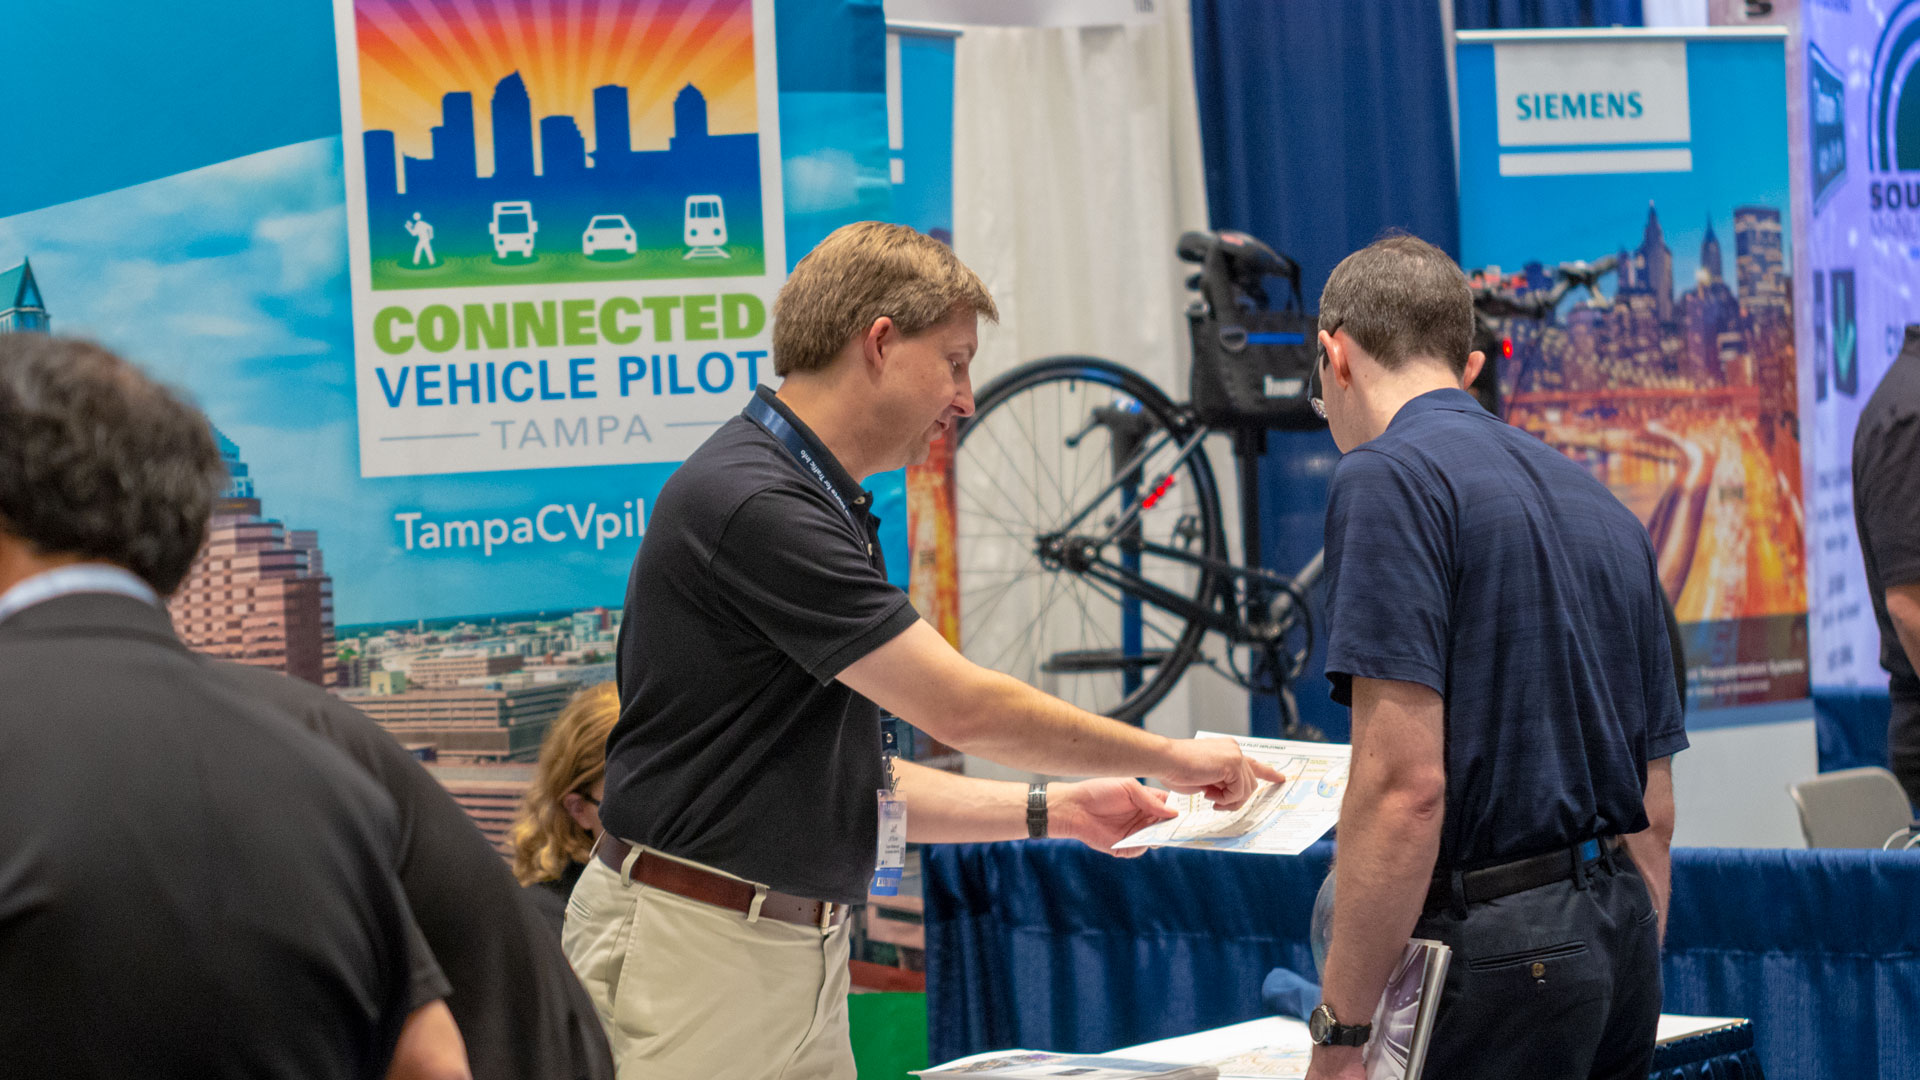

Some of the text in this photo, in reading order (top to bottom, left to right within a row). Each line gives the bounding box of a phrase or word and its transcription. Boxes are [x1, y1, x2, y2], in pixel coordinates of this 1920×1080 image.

[1516, 91, 1644, 121] SIEMENS
[373, 293, 766, 356] CONNECTED
[375, 350, 769, 408] VEHICLE PILOT
[491, 414, 653, 450] TAMPA
[801, 449, 811, 463] Info
[810, 461, 825, 481] Traffic
[824, 480, 832, 490] for
[395, 498, 647, 556] TampaCVpil
